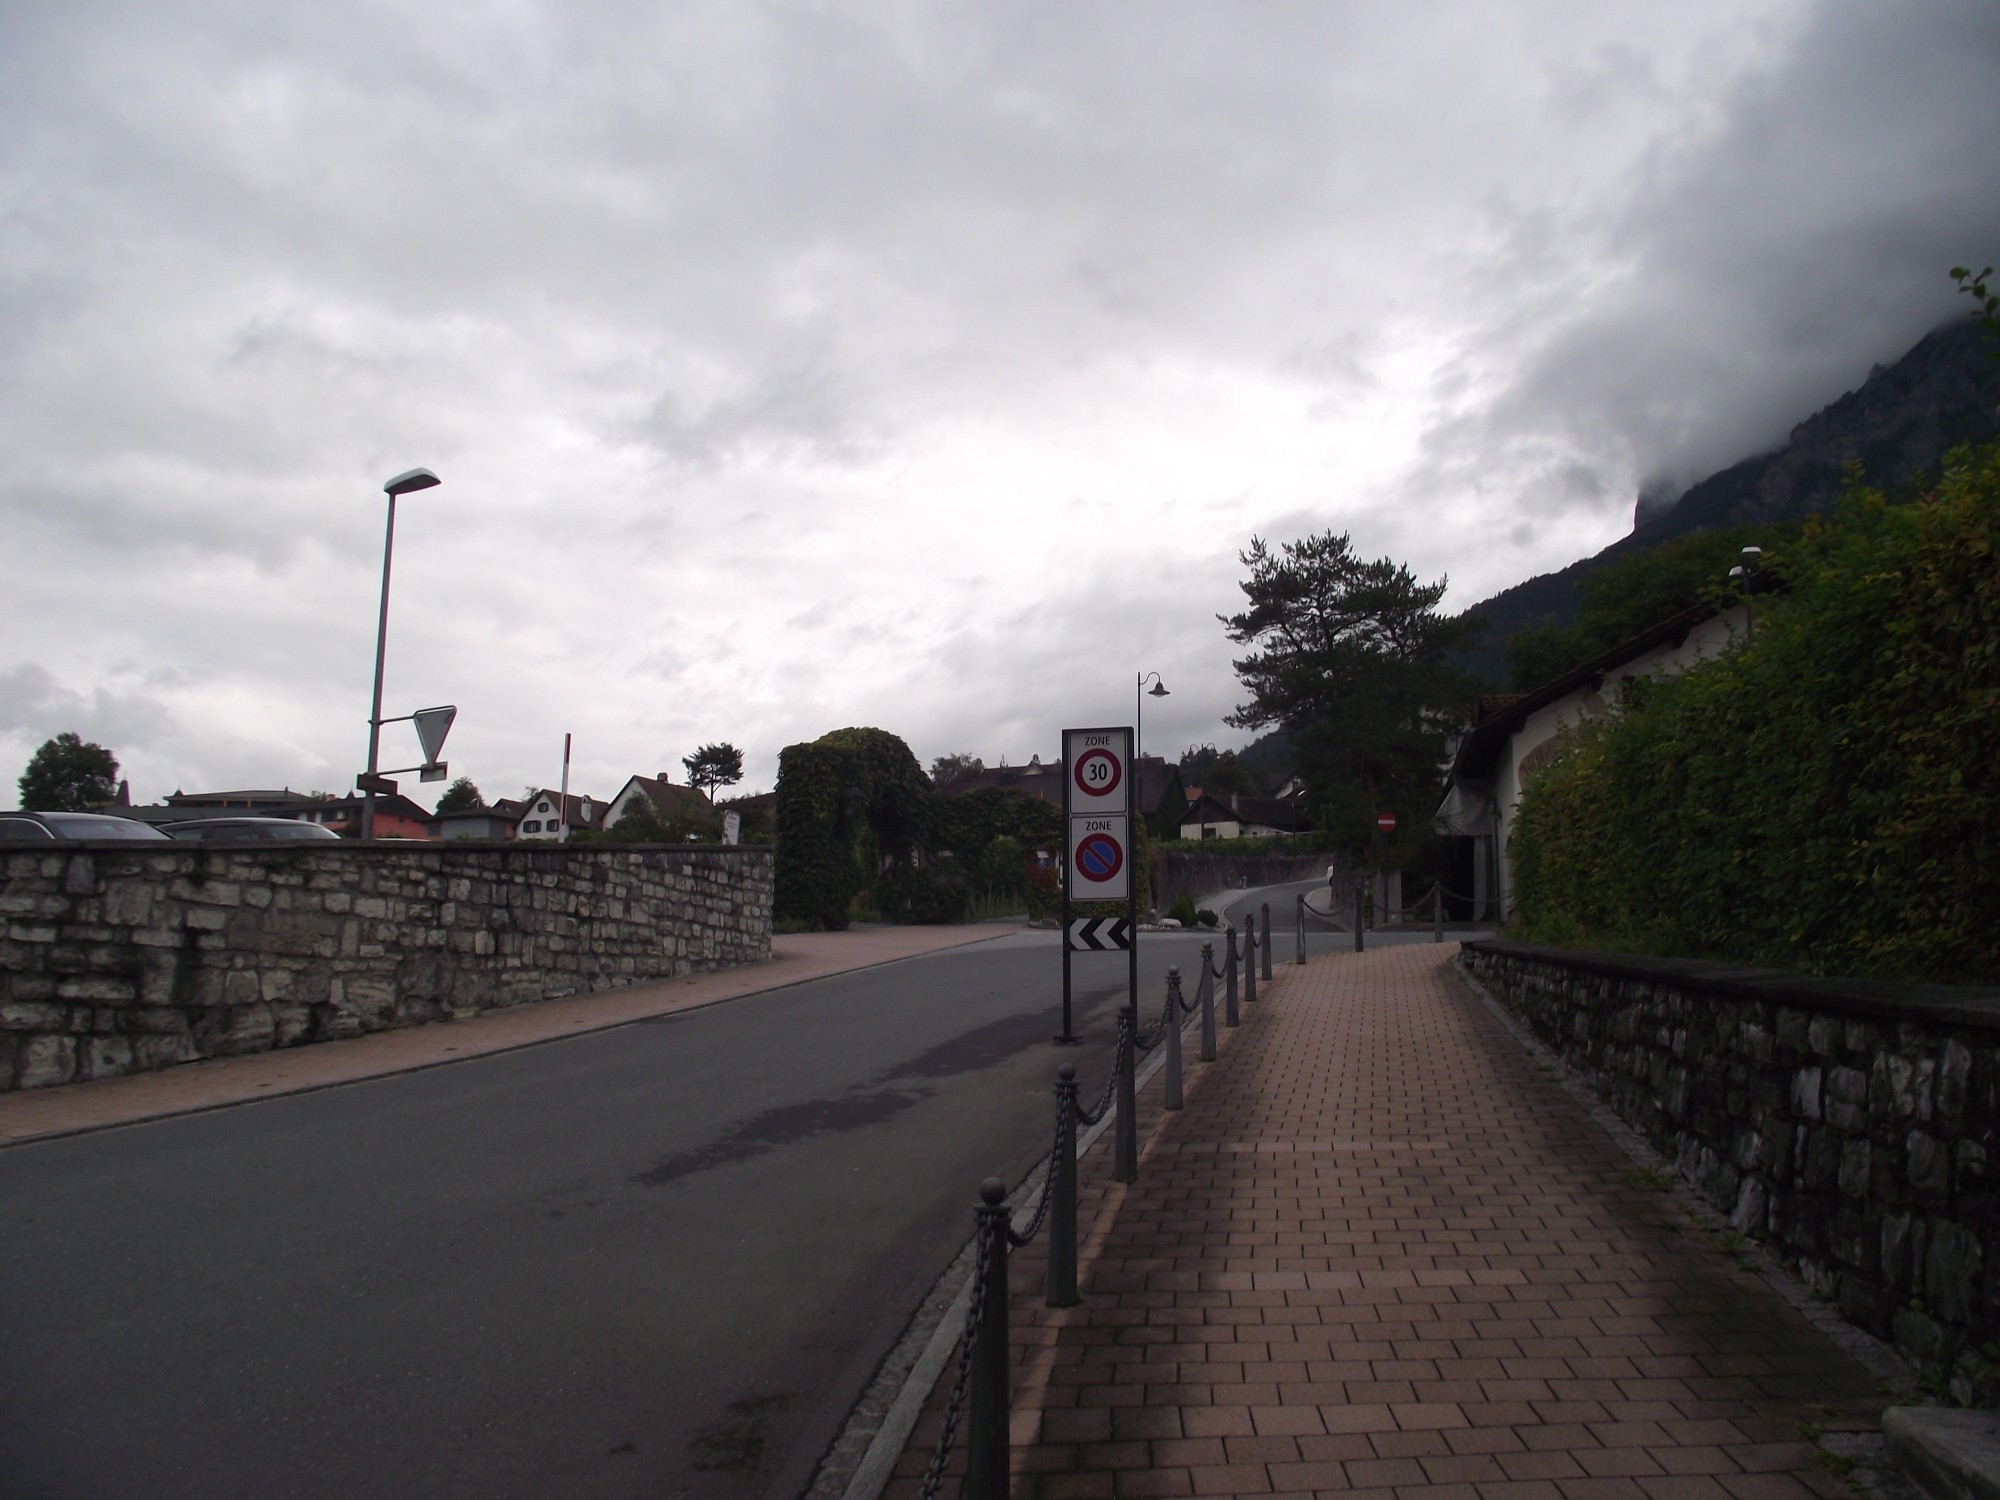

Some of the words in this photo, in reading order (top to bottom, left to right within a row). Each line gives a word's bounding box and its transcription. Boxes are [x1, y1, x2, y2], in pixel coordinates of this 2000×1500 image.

[1085, 735, 1111, 746] ZONE
[1089, 763, 1107, 781] 30
[1085, 820, 1112, 831] ZONE
